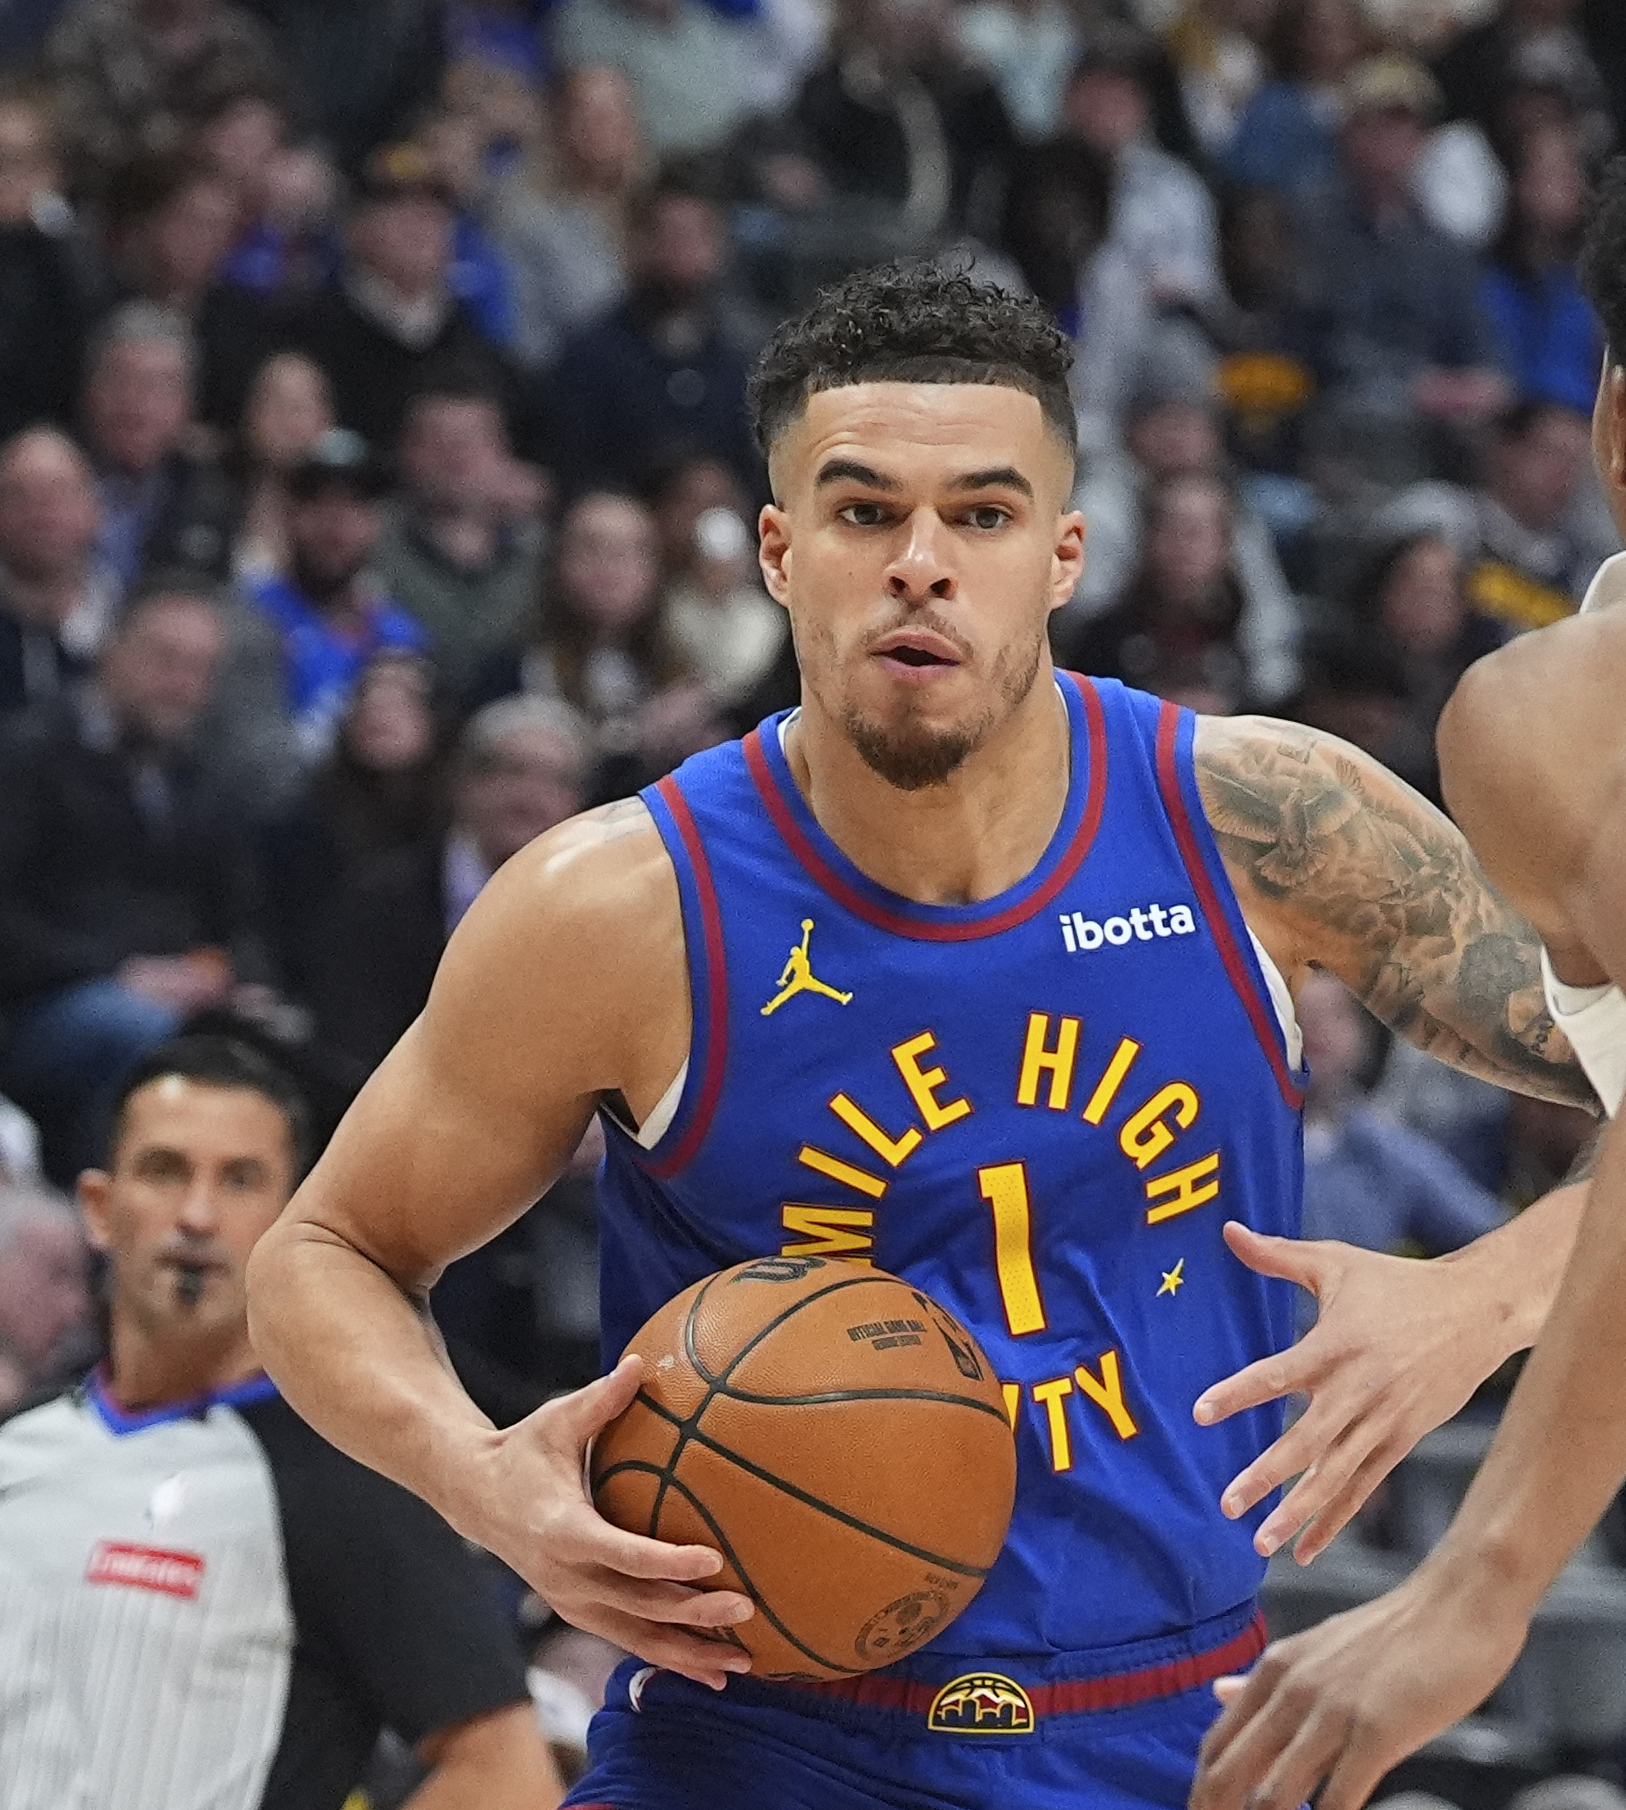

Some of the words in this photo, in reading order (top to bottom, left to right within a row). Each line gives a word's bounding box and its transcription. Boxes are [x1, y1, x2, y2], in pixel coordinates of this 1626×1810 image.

[1058, 902, 1197, 953] ibotta
[780, 1030, 972, 1266] MILE
[1015, 1011, 1221, 1225] HIGH
[977, 1161, 1048, 1337] 1
[1002, 1349, 1139, 1473] TY
